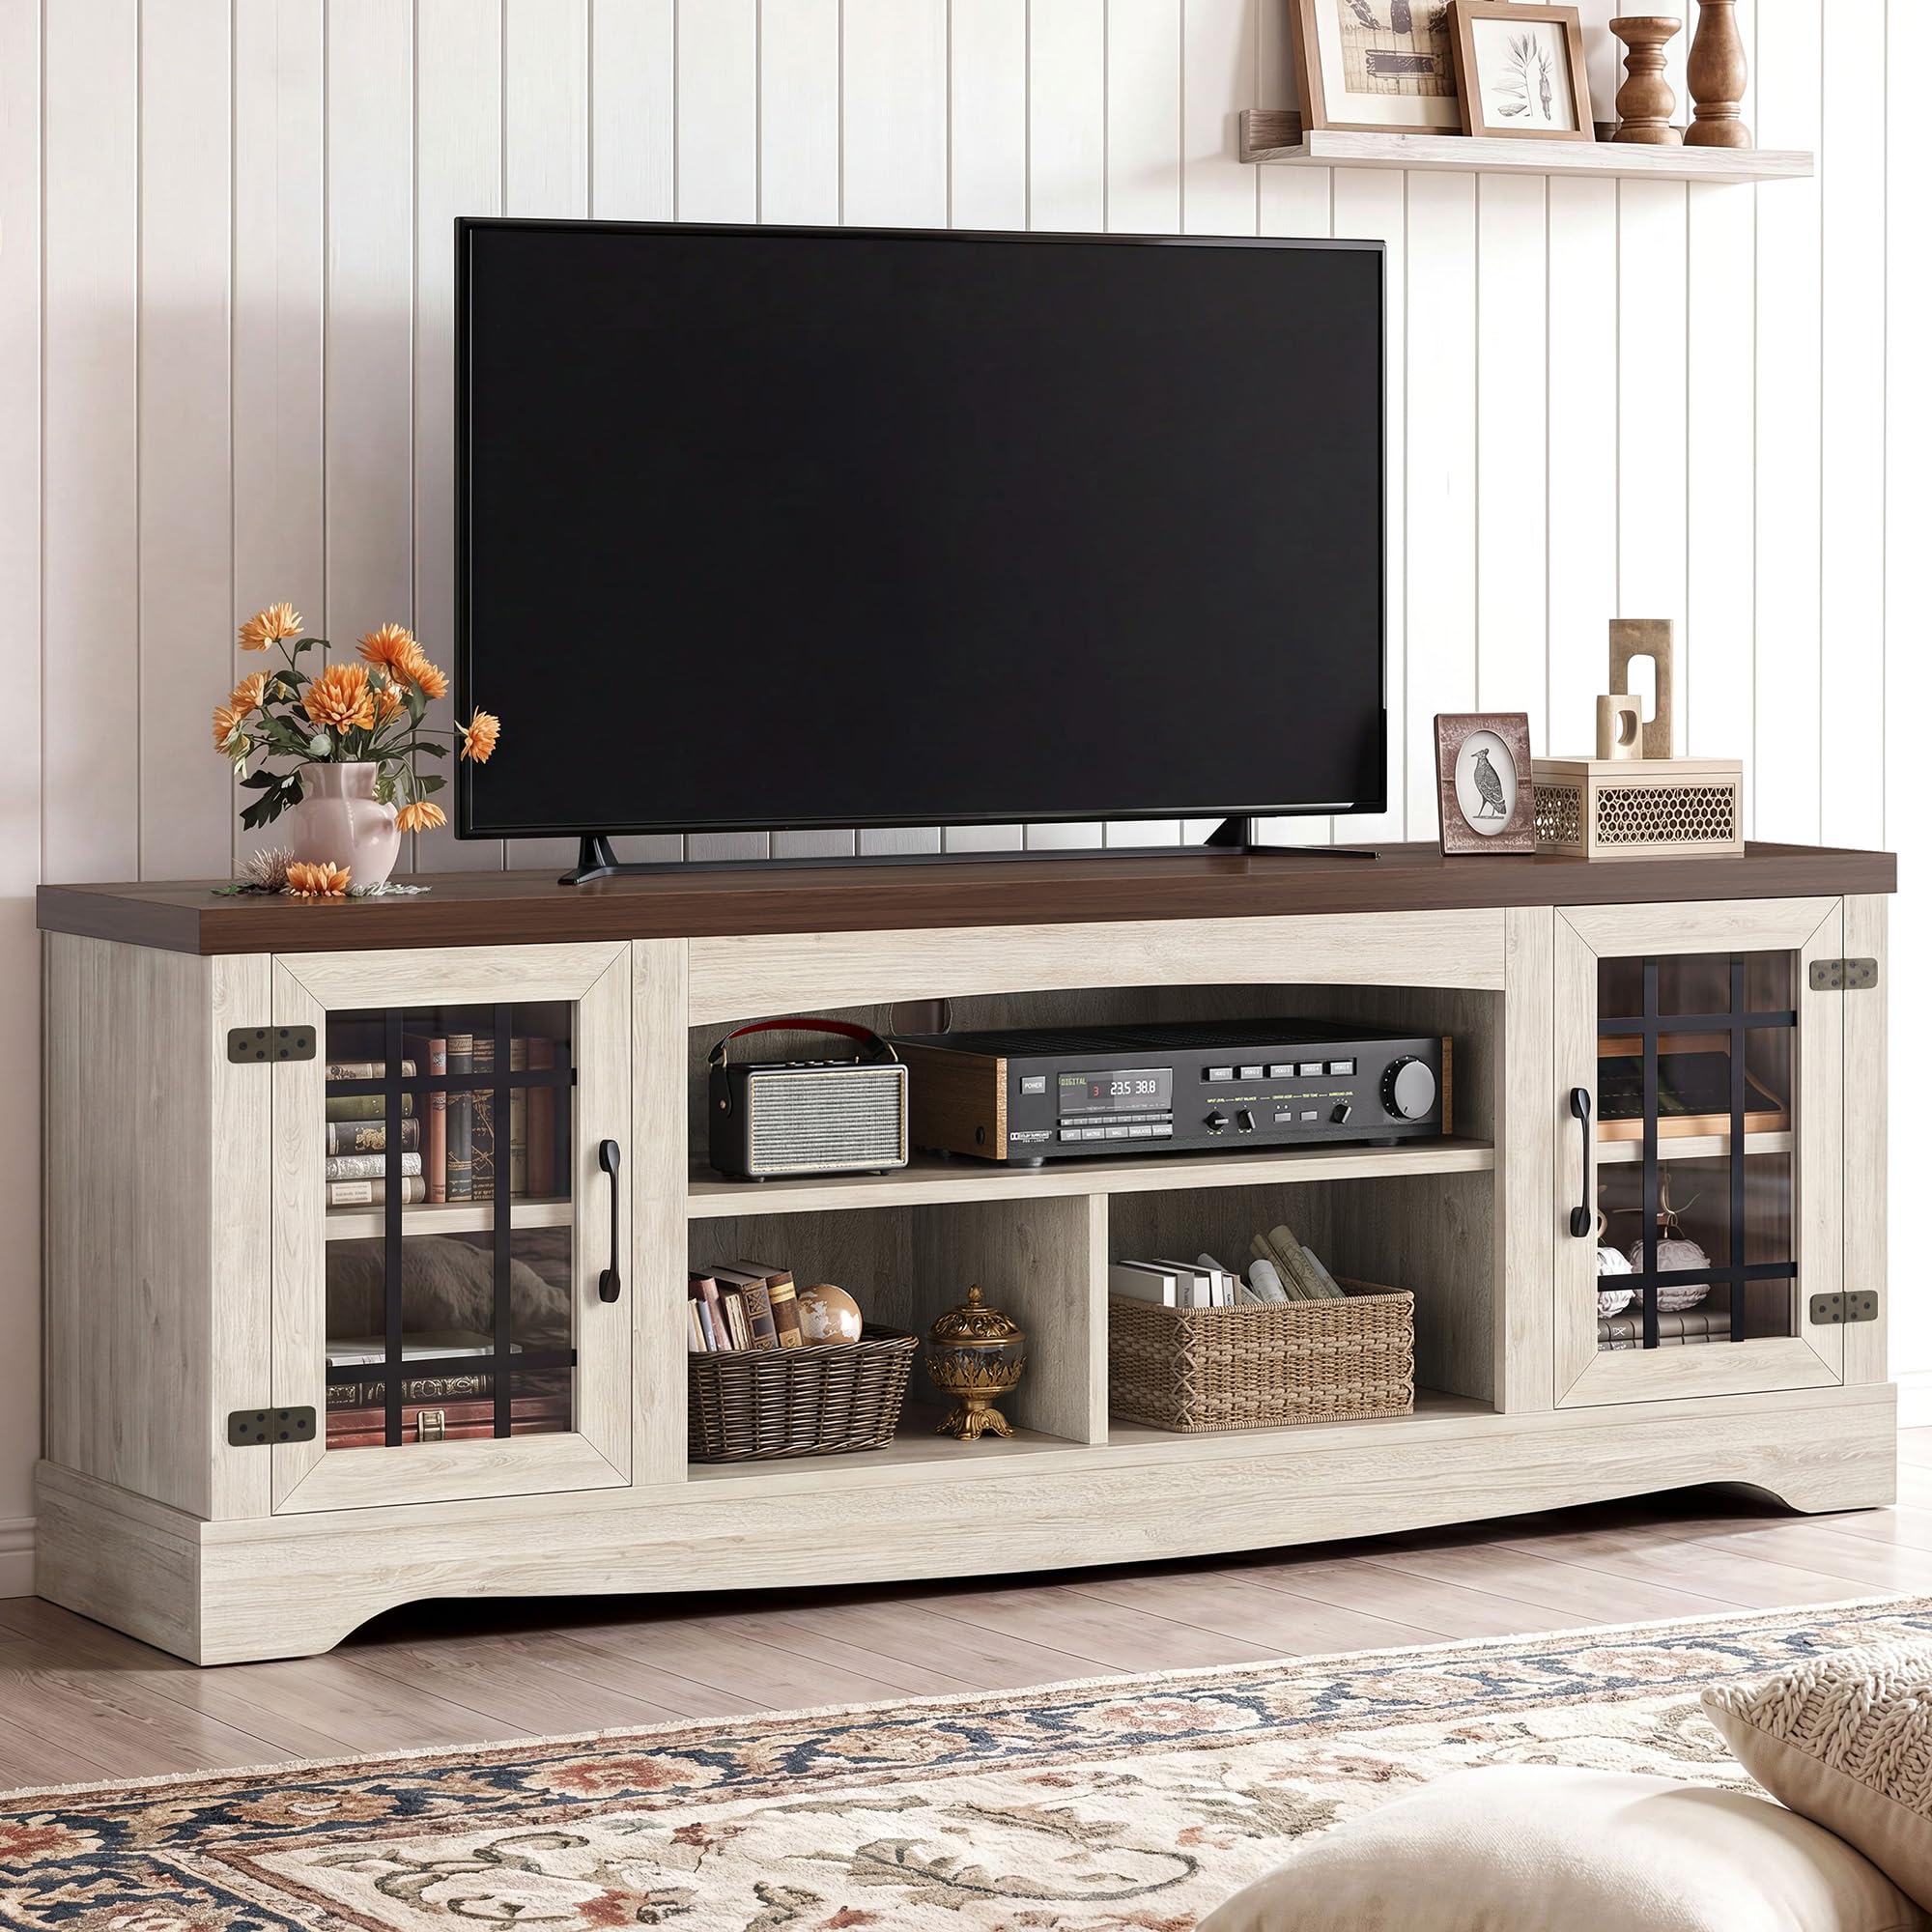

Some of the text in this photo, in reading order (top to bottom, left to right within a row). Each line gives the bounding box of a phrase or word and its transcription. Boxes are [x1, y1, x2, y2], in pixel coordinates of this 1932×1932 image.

[1061, 1077, 1087, 1086] DIGITAL
[1093, 1080, 1156, 1096] 3 23.5 38.8
